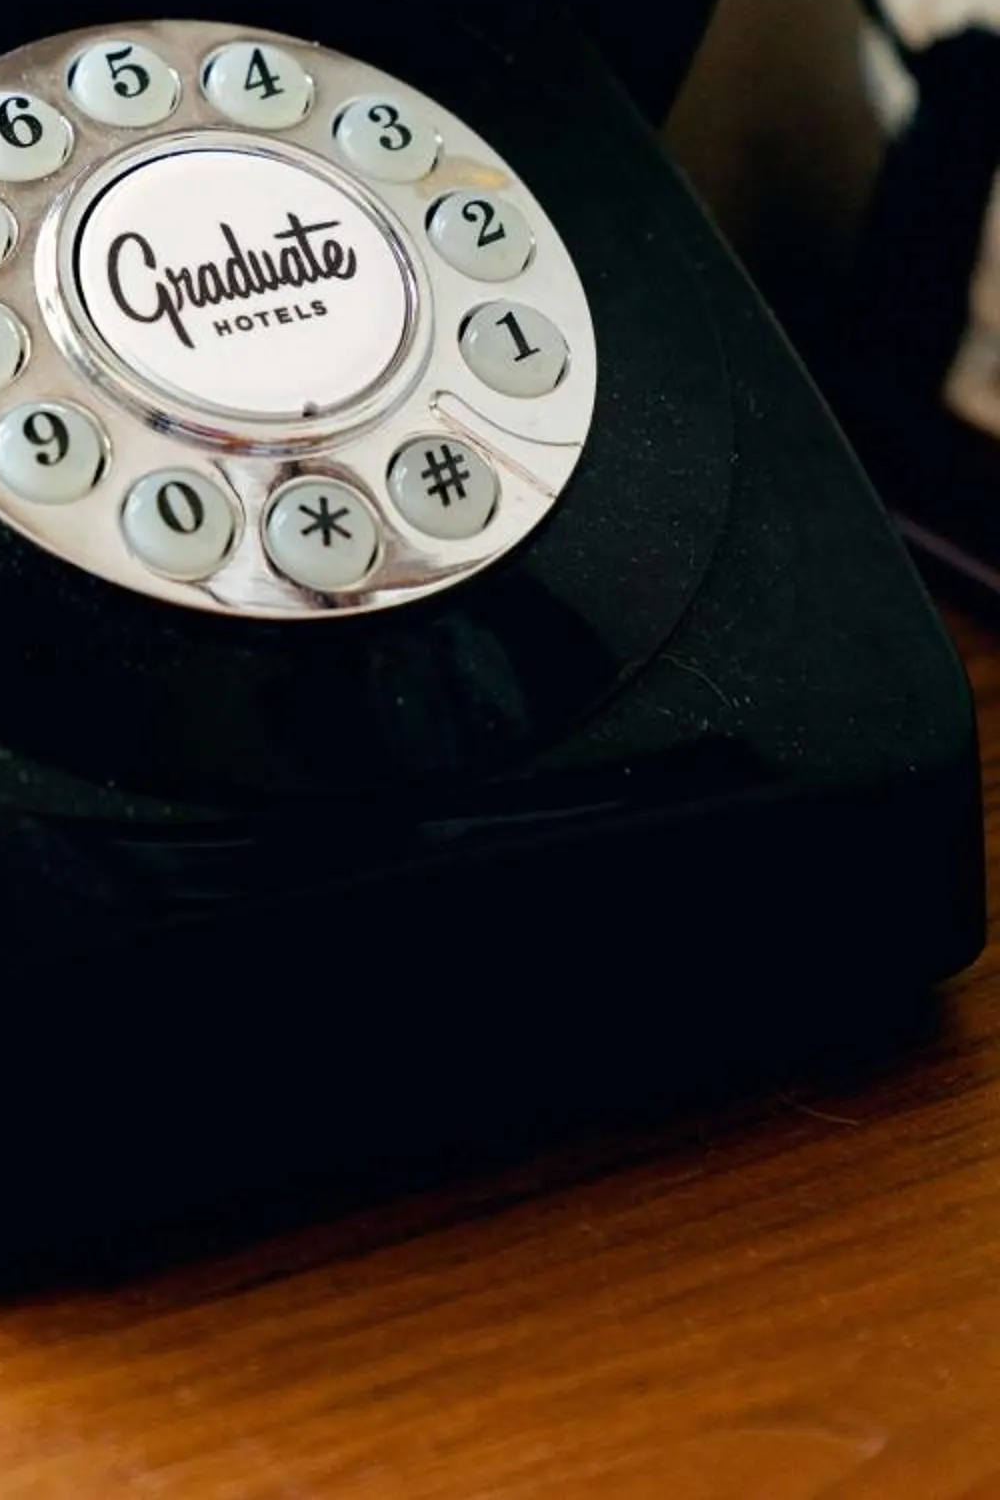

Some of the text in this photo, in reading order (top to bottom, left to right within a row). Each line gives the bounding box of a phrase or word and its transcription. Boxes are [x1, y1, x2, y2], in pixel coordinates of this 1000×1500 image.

[105, 46, 150, 99] 5
[243, 47, 282, 100] 4
[367, 104, 413, 151] 3
[461, 199, 506, 248] 2
[107, 212, 358, 349] Graduate
[212, 299, 328, 337] HOTELS
[495, 311, 541, 363] 1
[22, 411, 70, 467] 9
[156, 480, 205, 535] 0
